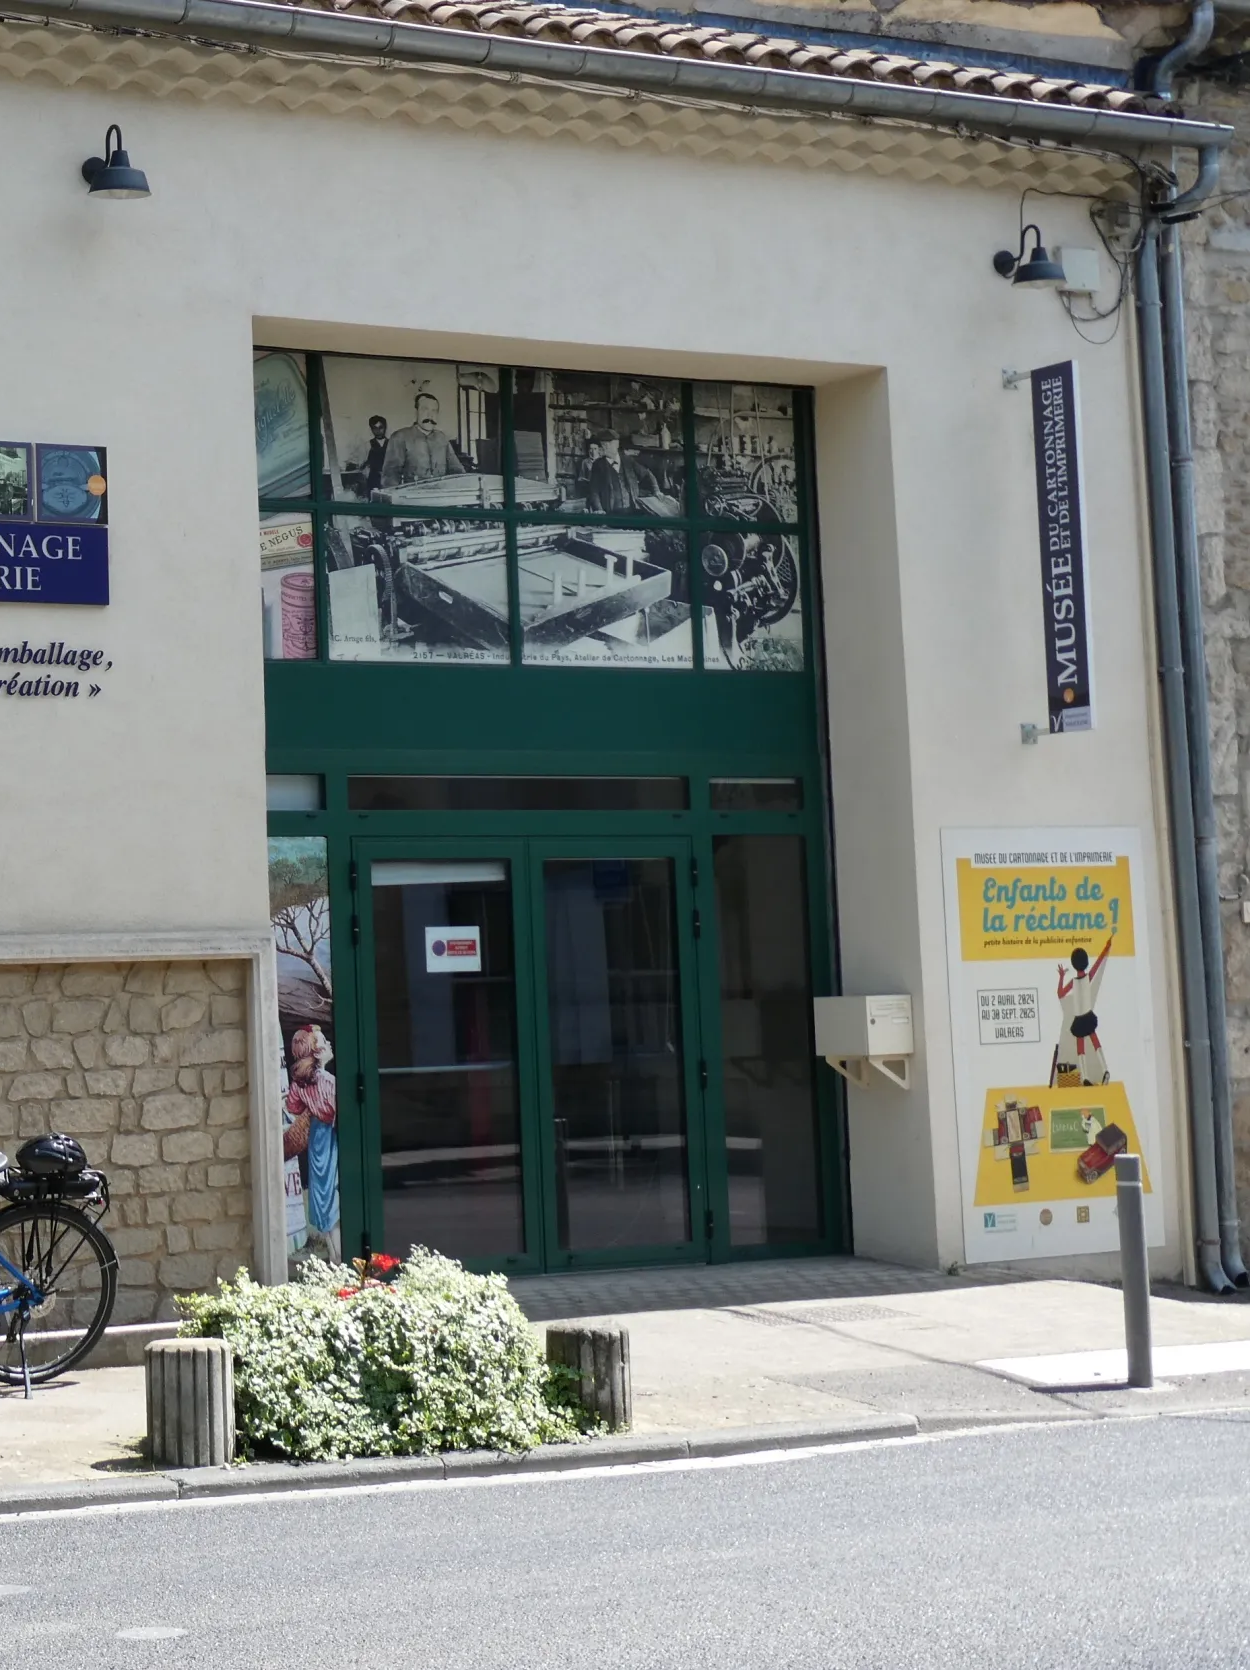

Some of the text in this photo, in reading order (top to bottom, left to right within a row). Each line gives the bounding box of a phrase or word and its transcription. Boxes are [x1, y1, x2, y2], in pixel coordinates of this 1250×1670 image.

[1041, 379, 1060, 551] DU CARTONNAGE
[1052, 376, 1071, 549] ET DE L'IMPRIMERIE
[1046, 553, 1078, 687] MUSÉE
[413, 652, 433, 660] 2157
[539, 654, 549, 662] du
[574, 653, 600, 662] Atelier
[602, 653, 611, 662] de
[613, 654, 660, 664] Cartonnage,
[661, 655, 676, 663] Les
[998, 852, 1008, 864] DU
[1008, 852, 1049, 864] CARTONNAGE
[1050, 852, 1059, 863] ET
[1060, 851, 1068, 863] DE
[983, 876, 1104, 909] Enfants de
[983, 907, 1007, 933] la
[984, 935, 1092, 948] petite histoire de la publicité enfantine
[980, 993, 1035, 1007] DU 2 AVRIL 2024
[981, 1007, 1036, 1020] AU 30 SEPT. 2025
